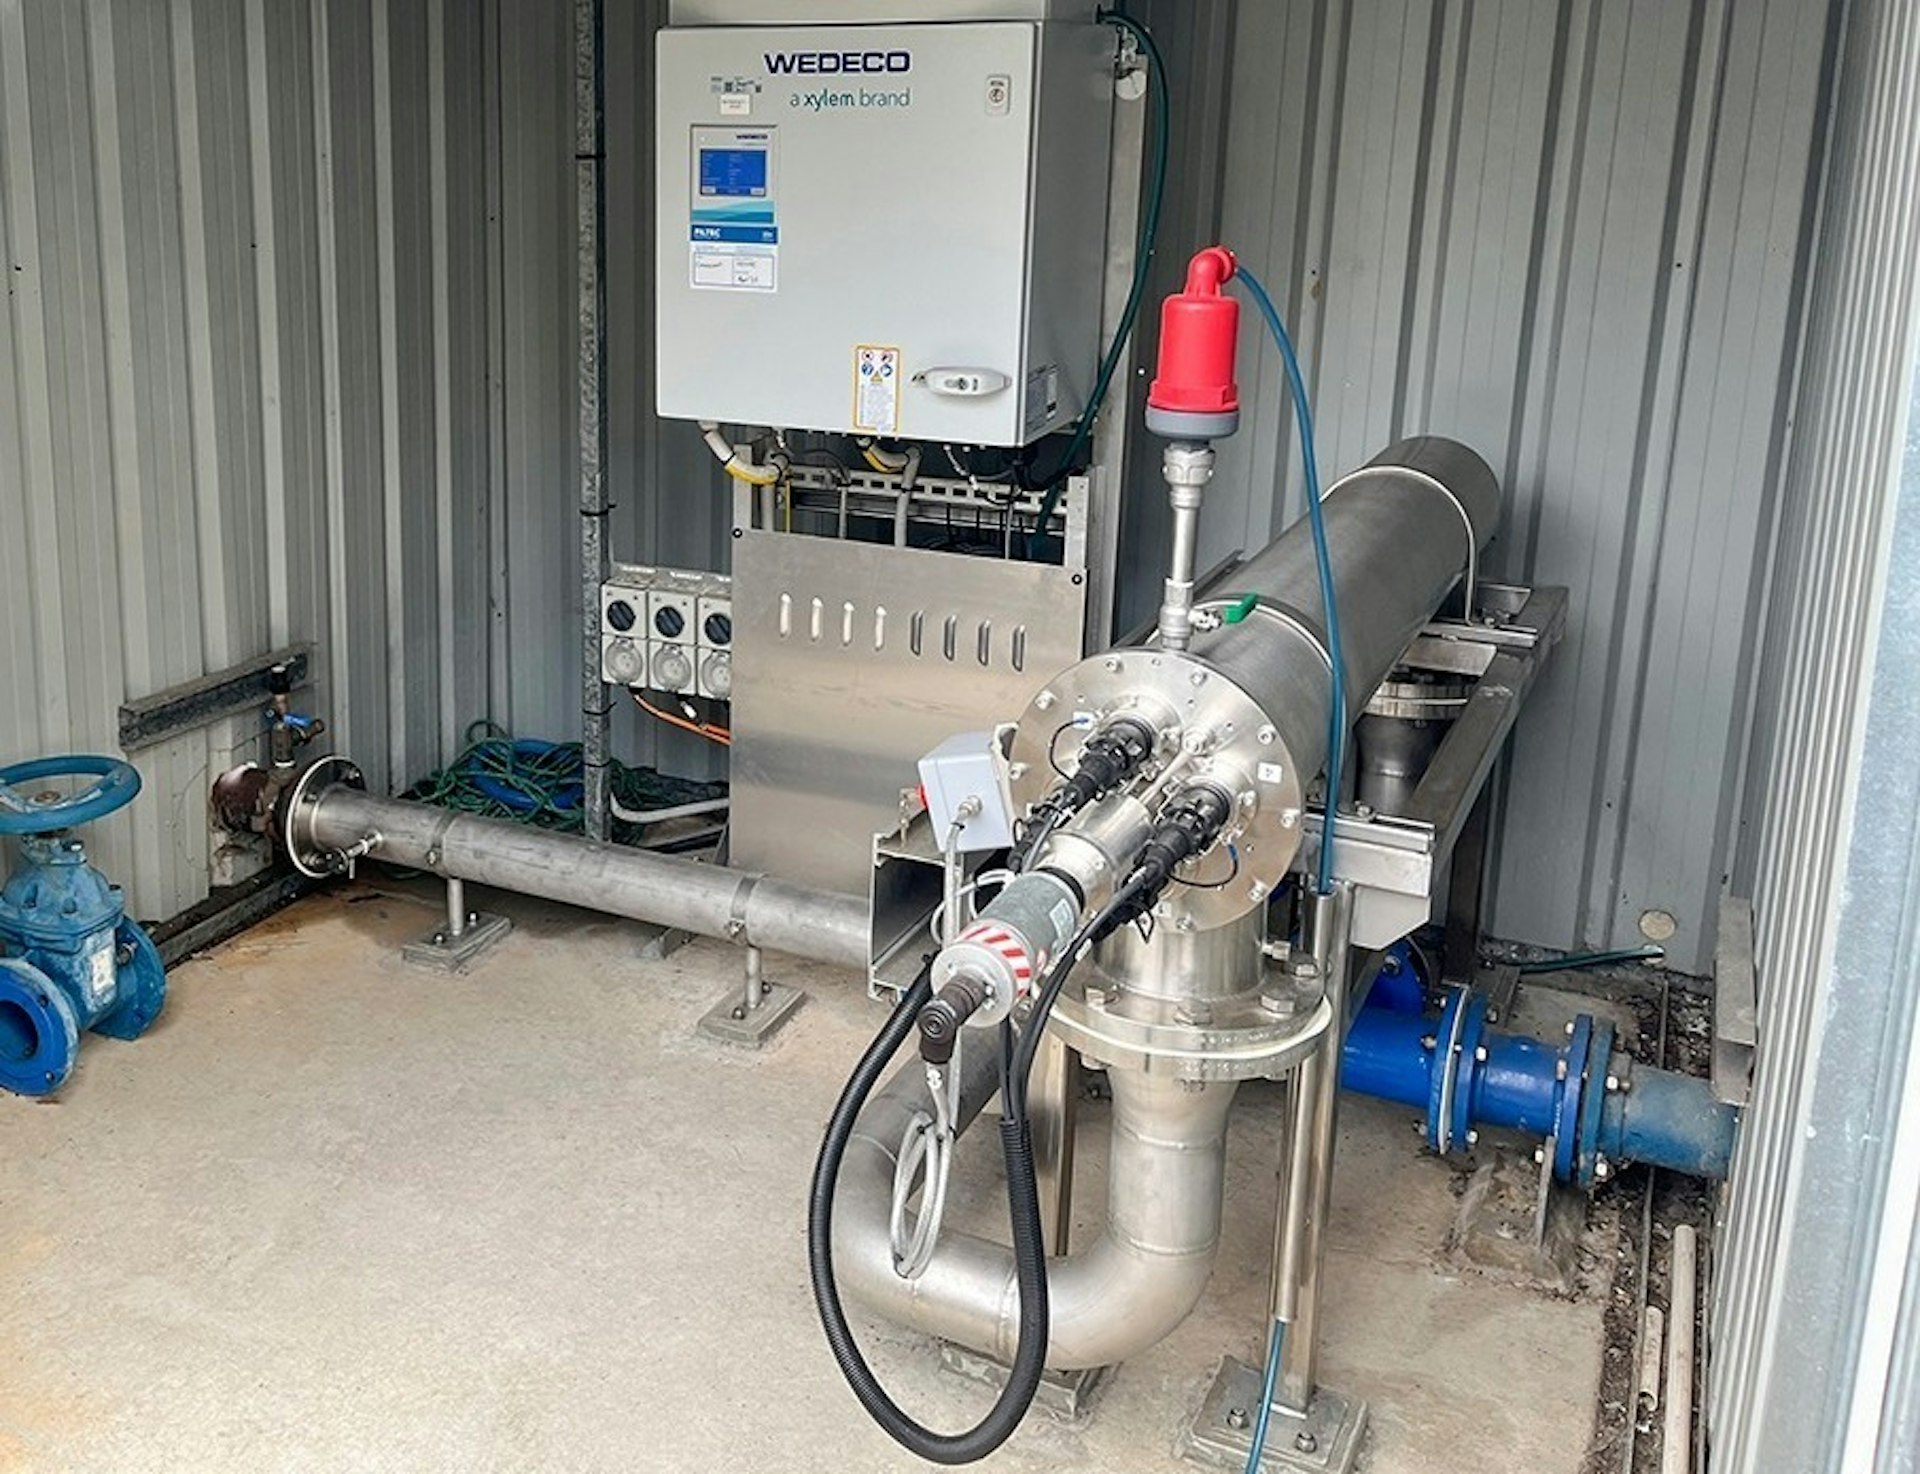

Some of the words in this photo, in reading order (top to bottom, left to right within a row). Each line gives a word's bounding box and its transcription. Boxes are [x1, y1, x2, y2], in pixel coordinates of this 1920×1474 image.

[764, 52, 910, 74] WEDECO
[790, 94, 800, 107] a
[803, 88, 855, 112] xylem
[859, 87, 910, 107] brand
